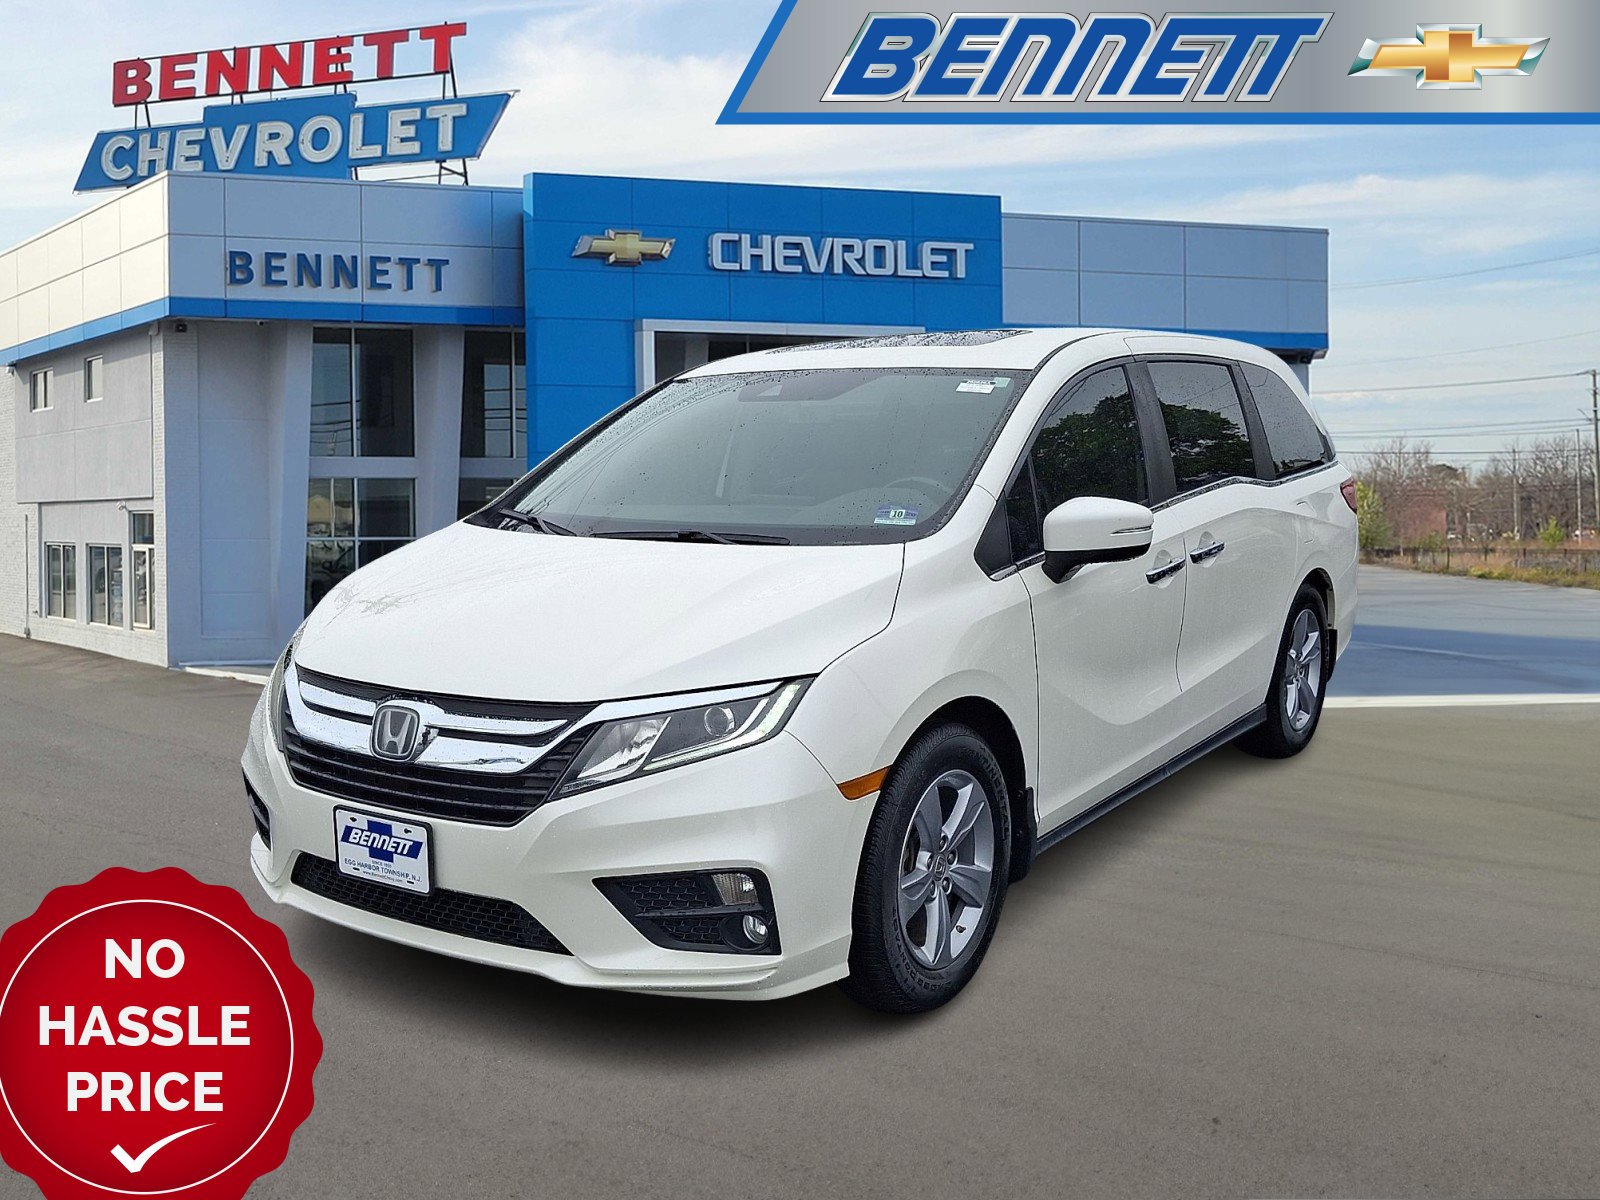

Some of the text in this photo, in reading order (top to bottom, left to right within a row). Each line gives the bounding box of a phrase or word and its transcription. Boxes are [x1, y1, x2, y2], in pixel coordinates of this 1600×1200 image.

[112, 22, 467, 107] BENNETT
[100, 103, 468, 180] CHEVROLET
[227, 250, 450, 293] BENNETT
[709, 233, 975, 278] CHEVROLET
[348, 828, 414, 855] BENNETT
[344, 857, 357, 866] EGG
[356, 861, 380, 872] HARBOR
